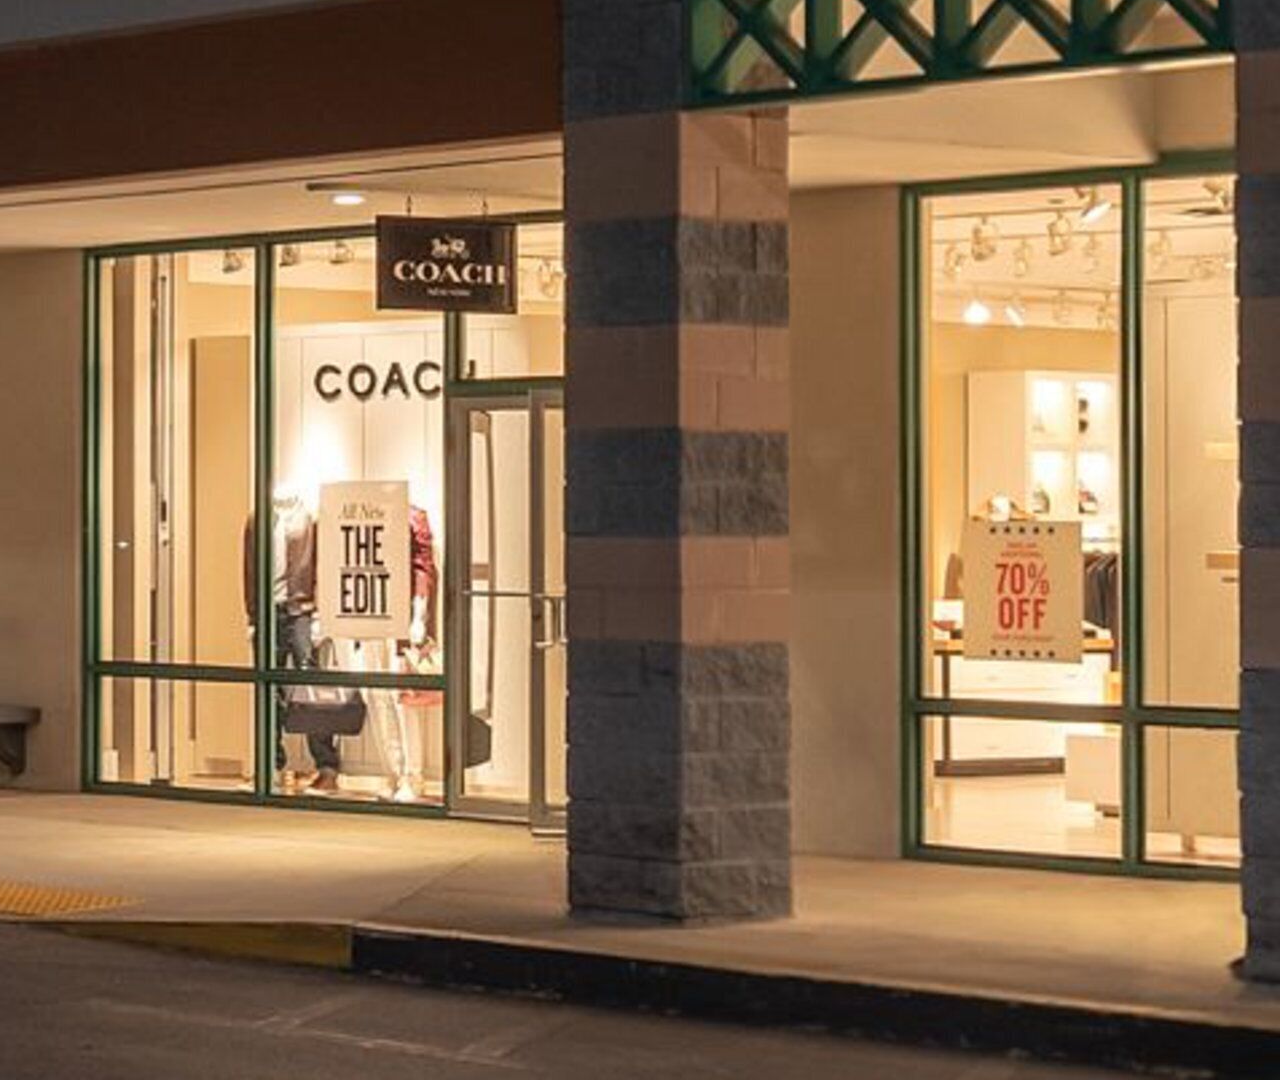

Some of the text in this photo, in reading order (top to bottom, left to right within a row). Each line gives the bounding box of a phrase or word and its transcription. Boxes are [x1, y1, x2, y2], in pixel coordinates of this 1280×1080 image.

[393, 259, 506, 285] COACH
[340, 524, 385, 566] THE
[340, 573, 391, 615] EDIT
[994, 561, 1051, 596] 70%
[998, 597, 1048, 630] OFF
